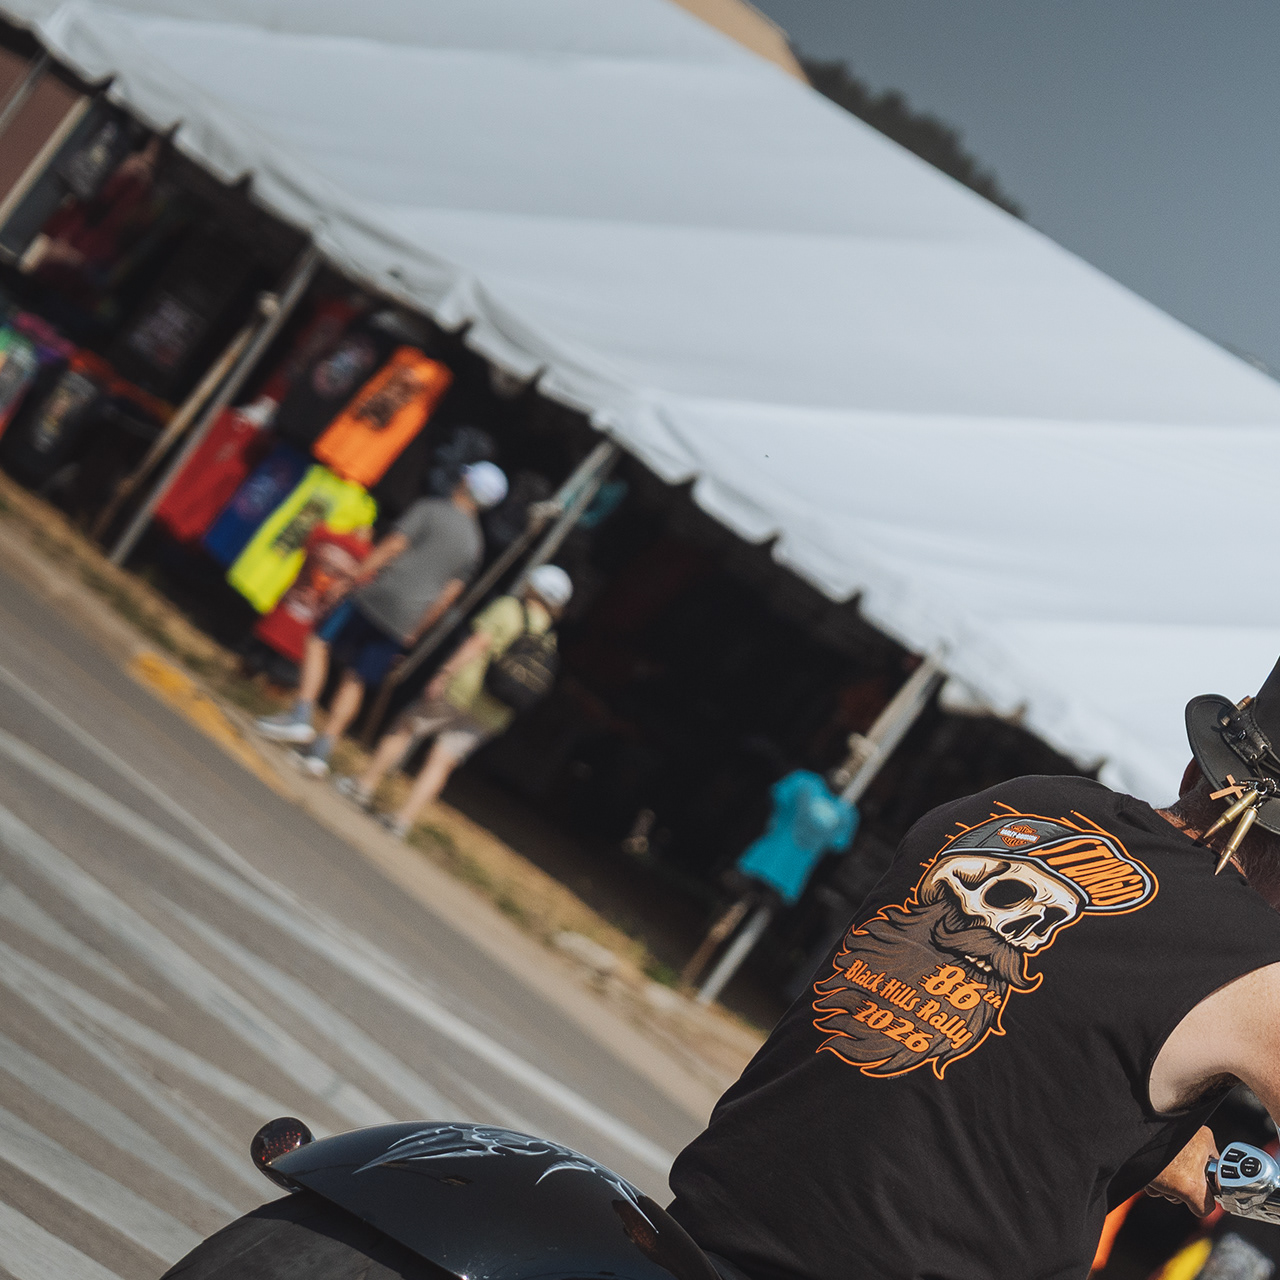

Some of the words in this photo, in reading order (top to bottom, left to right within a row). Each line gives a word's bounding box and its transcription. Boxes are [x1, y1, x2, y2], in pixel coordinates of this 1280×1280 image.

[1028, 838, 1144, 906] STURGIS
[843, 959, 886, 993] Black
[879, 978, 921, 1012] Hills
[914, 999, 975, 1050] Rally
[852, 1000, 934, 1053] 2026
